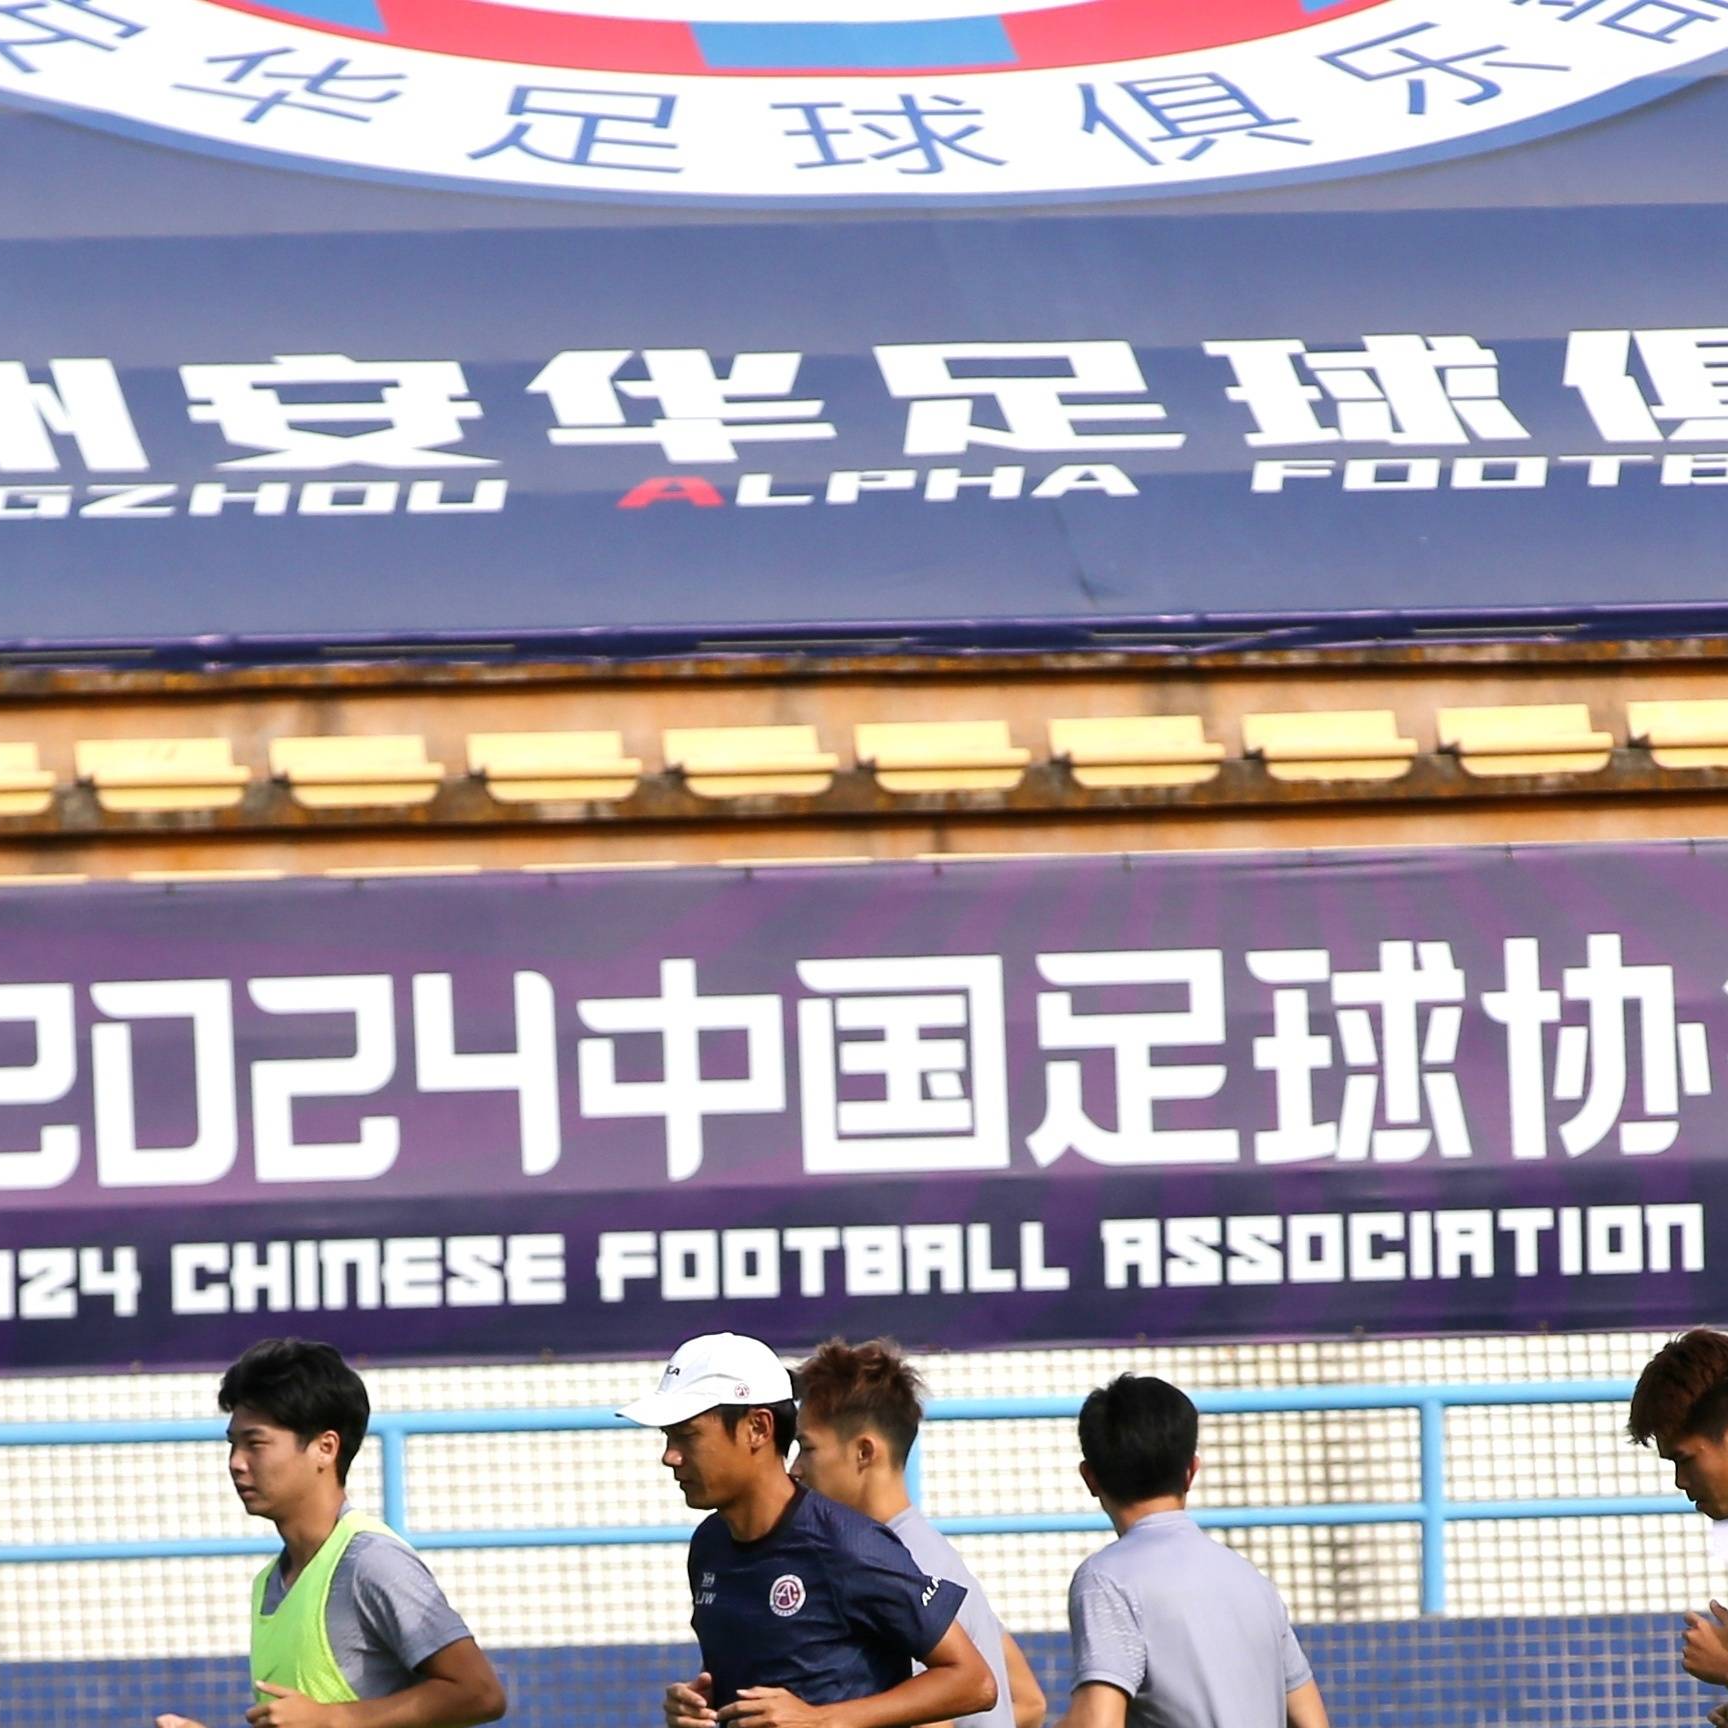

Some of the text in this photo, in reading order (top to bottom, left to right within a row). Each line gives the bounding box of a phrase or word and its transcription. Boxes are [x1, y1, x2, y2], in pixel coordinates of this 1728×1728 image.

[617, 461, 1140, 511] ALPHA
[171, 1234, 565, 1313] CHINESE
[597, 1221, 1069, 1301] FOOTBALL
[1101, 1203, 1704, 1287] ASSOCIATION
